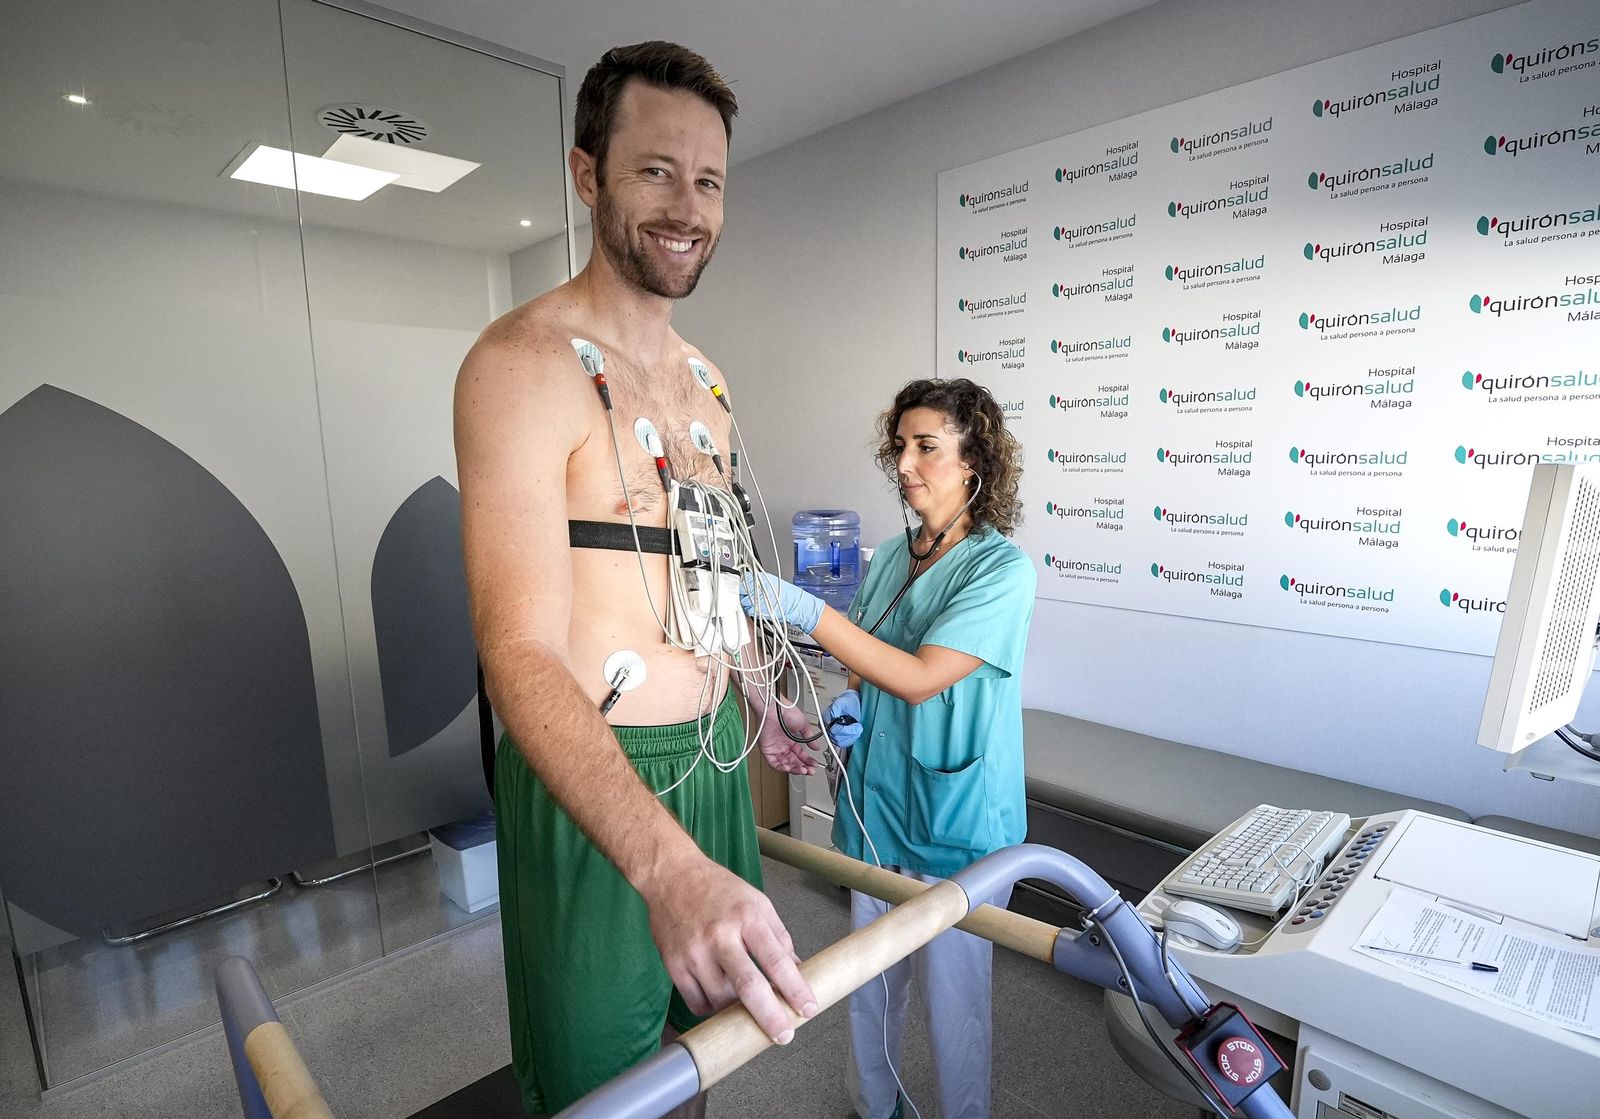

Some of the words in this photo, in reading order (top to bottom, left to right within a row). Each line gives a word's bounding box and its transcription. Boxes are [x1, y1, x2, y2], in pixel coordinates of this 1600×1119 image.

[1392, 60, 1441, 81] Hospital
[1520, 76, 1529, 84] La
[1532, 68, 1555, 81] salud
[1559, 61, 1595, 77] persona
[1330, 74, 1440, 118] quirónsalud
[1394, 98, 1438, 114] Málaga
[1106, 140, 1138, 156] Hospital
[1109, 170, 1137, 182] Málaga
[1325, 153, 1434, 191] quirónsalud
[1230, 174, 1269, 190] Hospital
[1339, 186, 1358, 197] salud
[1359, 182, 1389, 194] persona
[1397, 176, 1428, 189] persona
[1233, 207, 1267, 219] Málaga
[1380, 216, 1428, 232] Hospital
[1001, 227, 1028, 238] Hospital
[1516, 237, 1538, 245] salud
[1541, 232, 1577, 242] persona
[1320, 230, 1427, 263] quirónsalud
[1004, 253, 1027, 262] Málaga
[1383, 253, 1425, 264] Málaga
[1102, 264, 1134, 276] Hospital
[1105, 293, 1132, 302] Málaga
[1223, 310, 1260, 322] Hospital
[1315, 306, 1420, 333] quirónsalud
[999, 337, 1025, 346] Hospital
[1226, 341, 1258, 350] Málaga
[1369, 366, 1415, 378] Hospital
[1098, 384, 1129, 393] Hospital
[1482, 371, 1600, 394] quirónsalu
[1310, 379, 1414, 401] quirónsalud
[1371, 400, 1412, 409] Málaga
[1101, 410, 1128, 419] Málaga
[1216, 440, 1252, 449] Hospital
[1305, 451, 1407, 468] quirónsalud
[1218, 468, 1250, 478] Málaga
[1094, 498, 1124, 506] Hospital
[1357, 507, 1402, 517] Hospital
[1096, 522, 1123, 531] Málaga
[1300, 518, 1400, 533] quirónsalud
[1466, 526, 1522, 542] quiró
[1359, 537, 1398, 549] Málaga
[1208, 562, 1244, 572] Hospital
[1211, 588, 1242, 599] Málaga
[1295, 582, 1394, 601] quirónsalud
[1227, 1040, 1255, 1053] STOP
[1221, 1054, 1239, 1081] STOP
[1246, 1058, 1261, 1083] STOP
